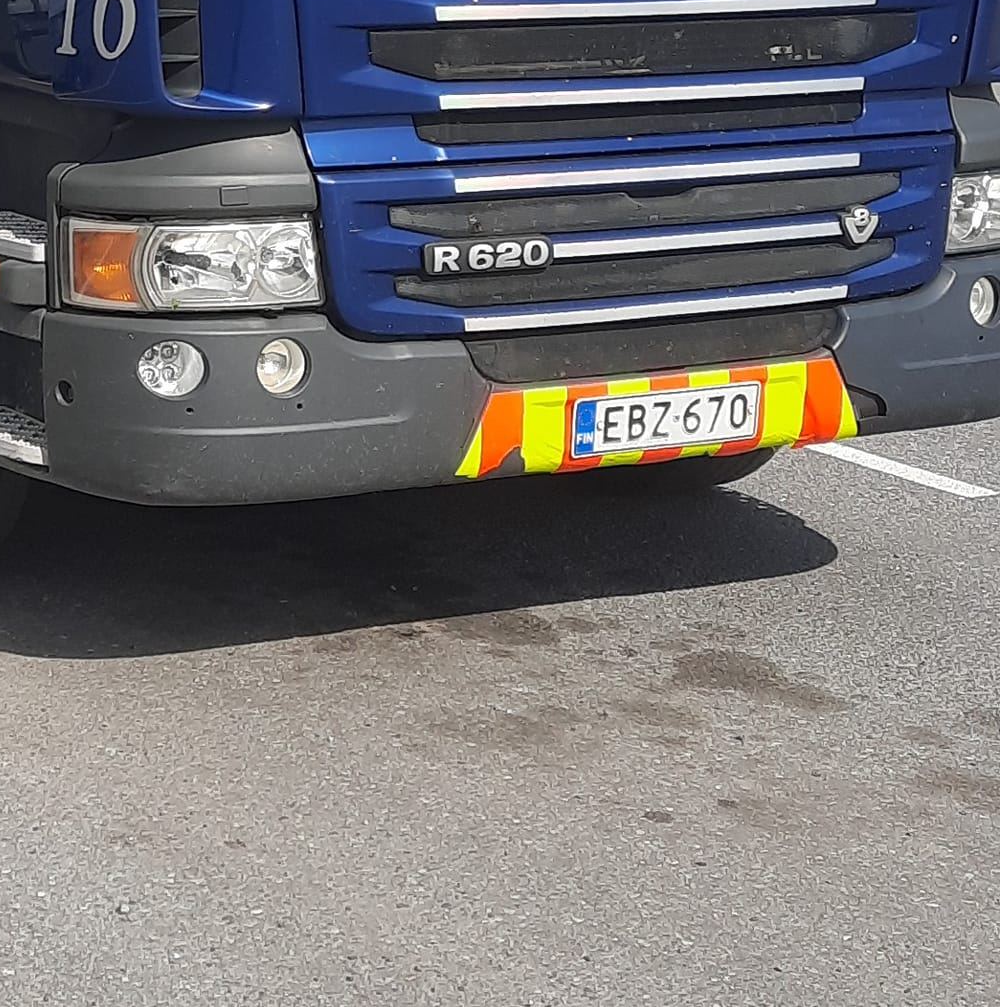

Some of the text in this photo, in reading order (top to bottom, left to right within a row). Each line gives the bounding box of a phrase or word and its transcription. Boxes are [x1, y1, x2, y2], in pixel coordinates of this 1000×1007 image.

[433, 240, 550, 273] R 620
[576, 430, 594, 446] FIN
